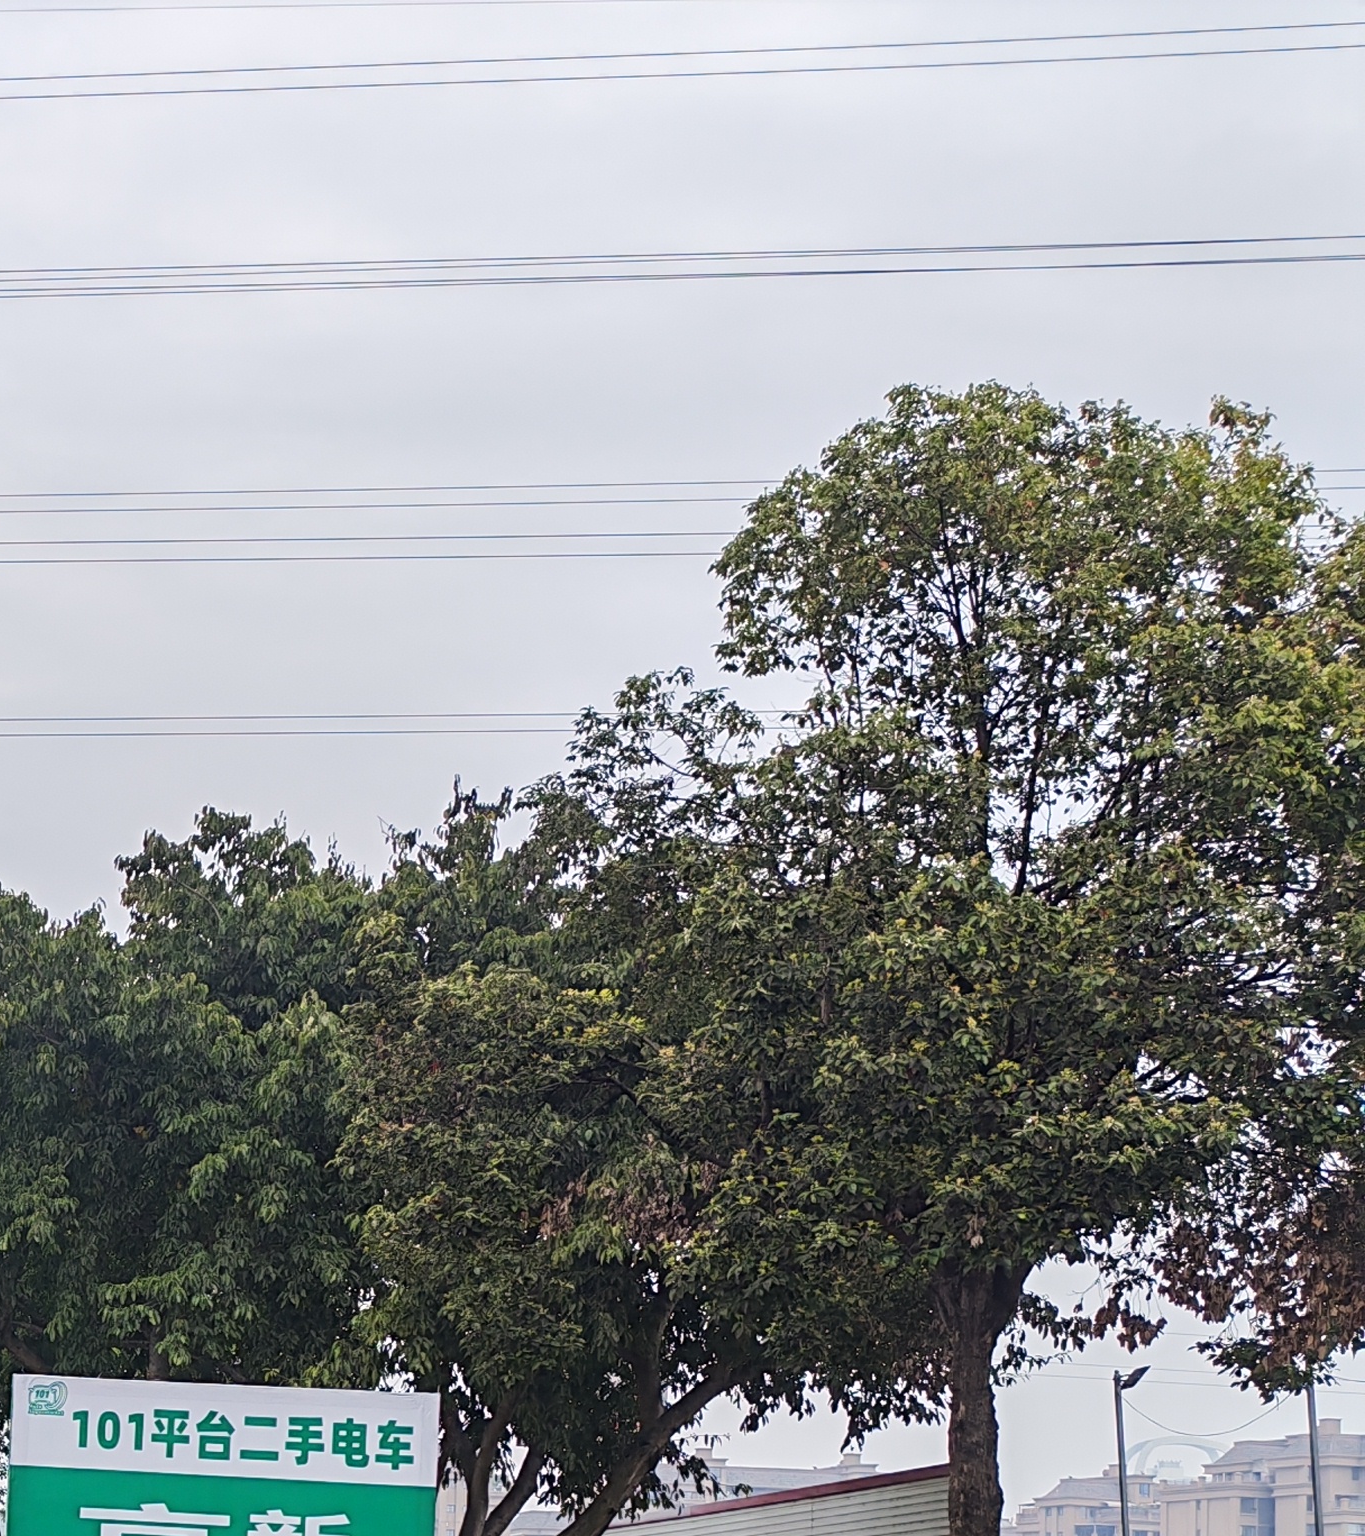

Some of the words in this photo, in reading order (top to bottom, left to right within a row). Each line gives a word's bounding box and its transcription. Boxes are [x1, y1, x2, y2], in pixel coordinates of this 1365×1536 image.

[72, 1408, 415, 1471] 101平台二手电车
